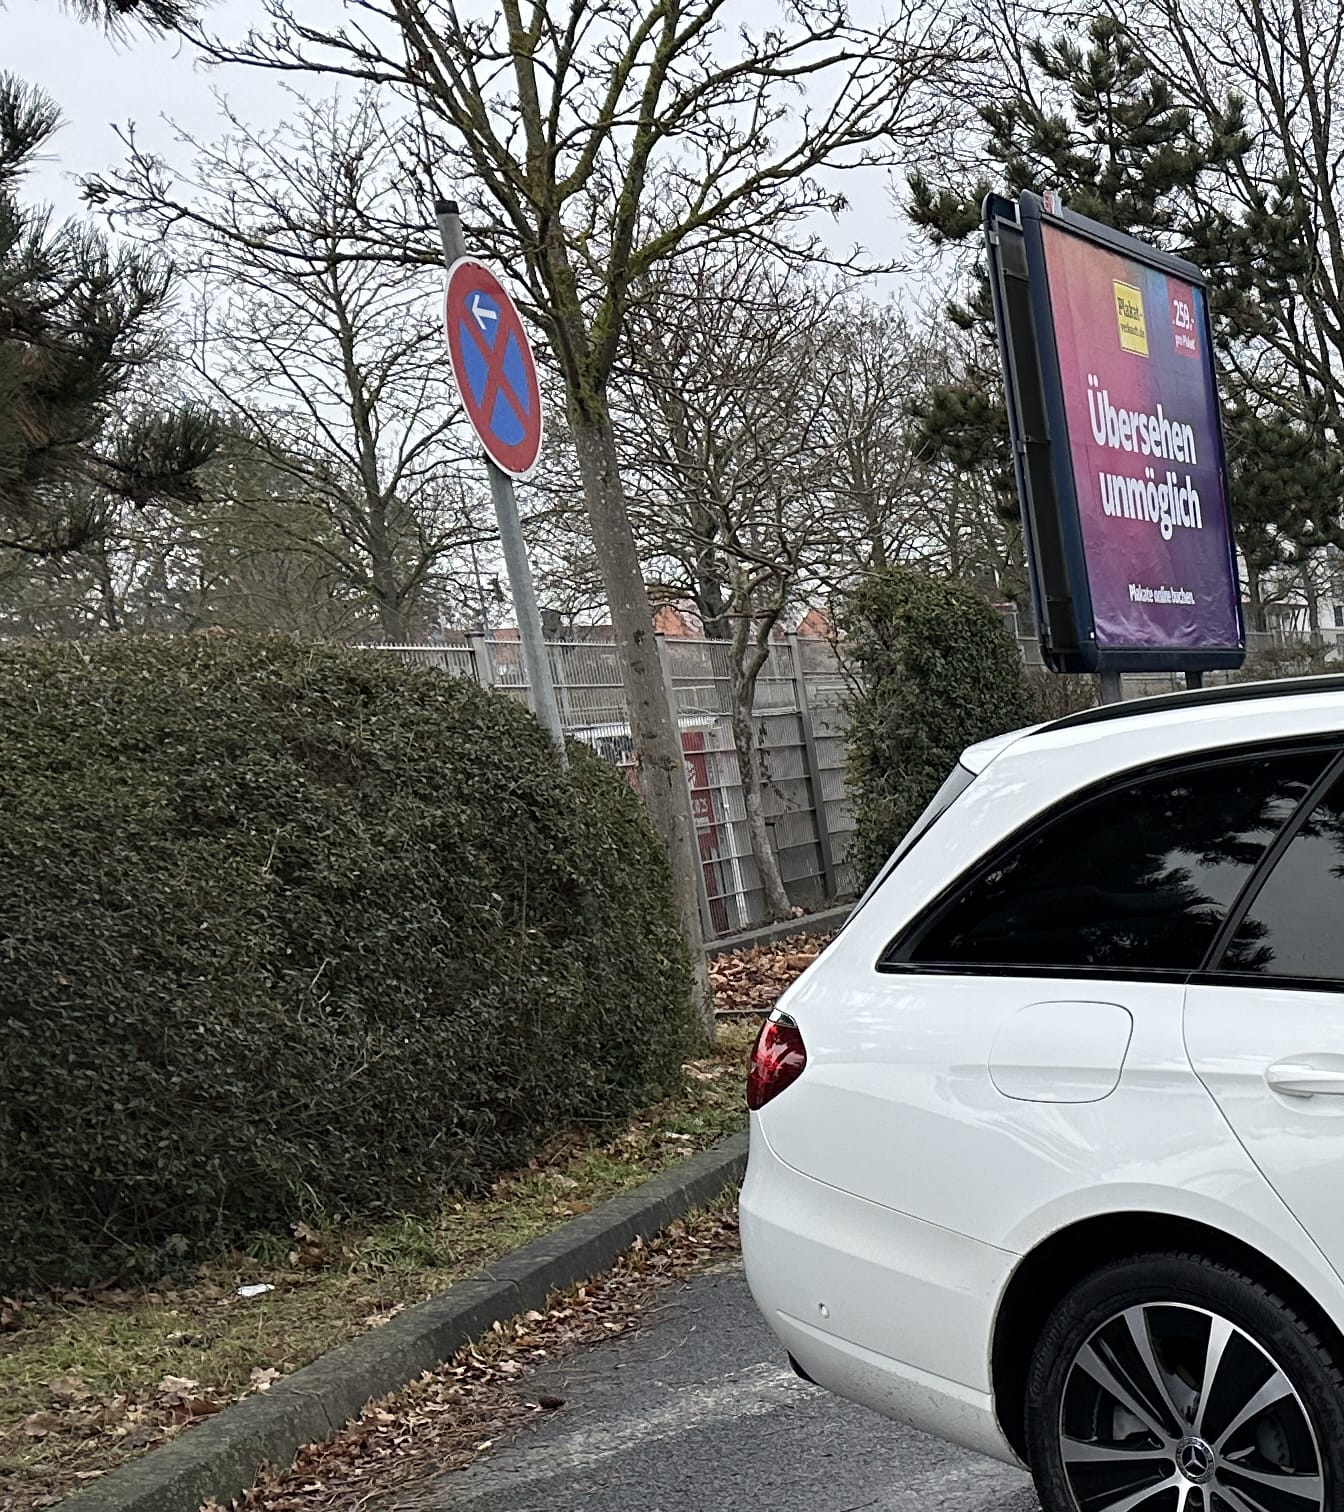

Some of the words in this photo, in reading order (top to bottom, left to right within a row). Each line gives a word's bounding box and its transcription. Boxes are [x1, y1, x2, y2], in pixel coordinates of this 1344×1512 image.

[1087, 373, 1197, 465] Übersehen
[1099, 466, 1203, 541] unmöglich
[1128, 583, 1154, 603] Plakate
[1154, 585, 1171, 604] online
